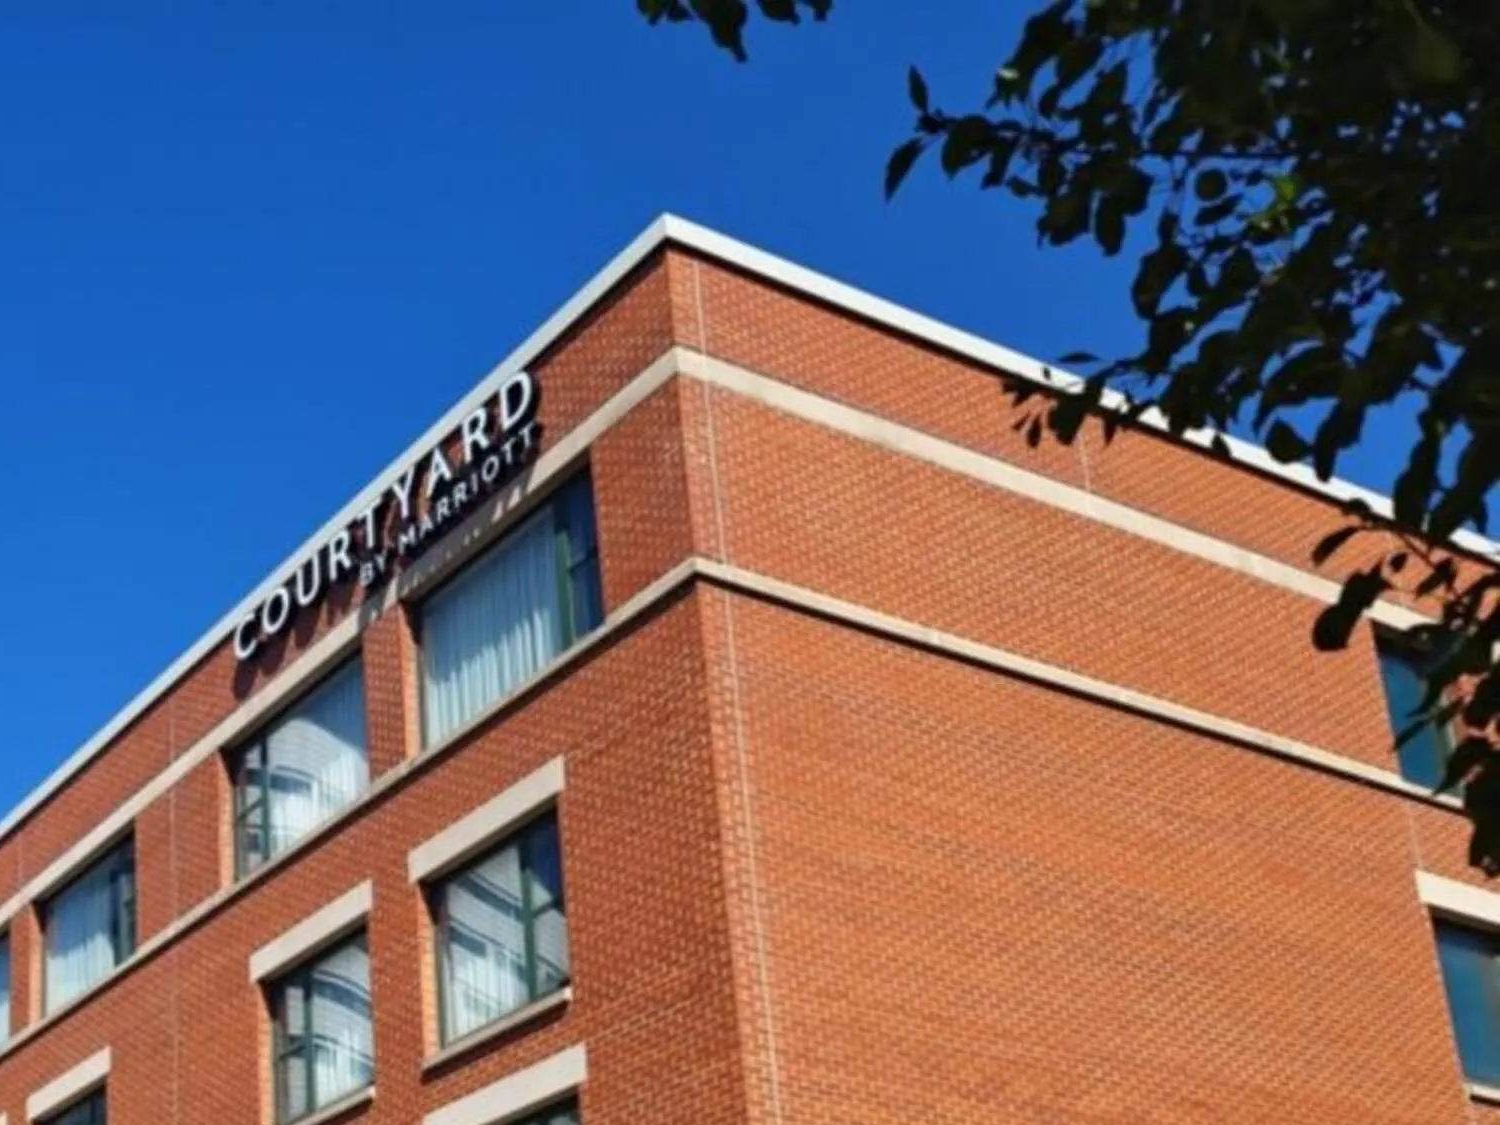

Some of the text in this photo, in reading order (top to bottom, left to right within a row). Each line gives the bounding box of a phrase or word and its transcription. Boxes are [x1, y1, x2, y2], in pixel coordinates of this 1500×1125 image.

[232, 371, 533, 661] COURTYARD
[358, 423, 536, 588] BY MARRIOTT
